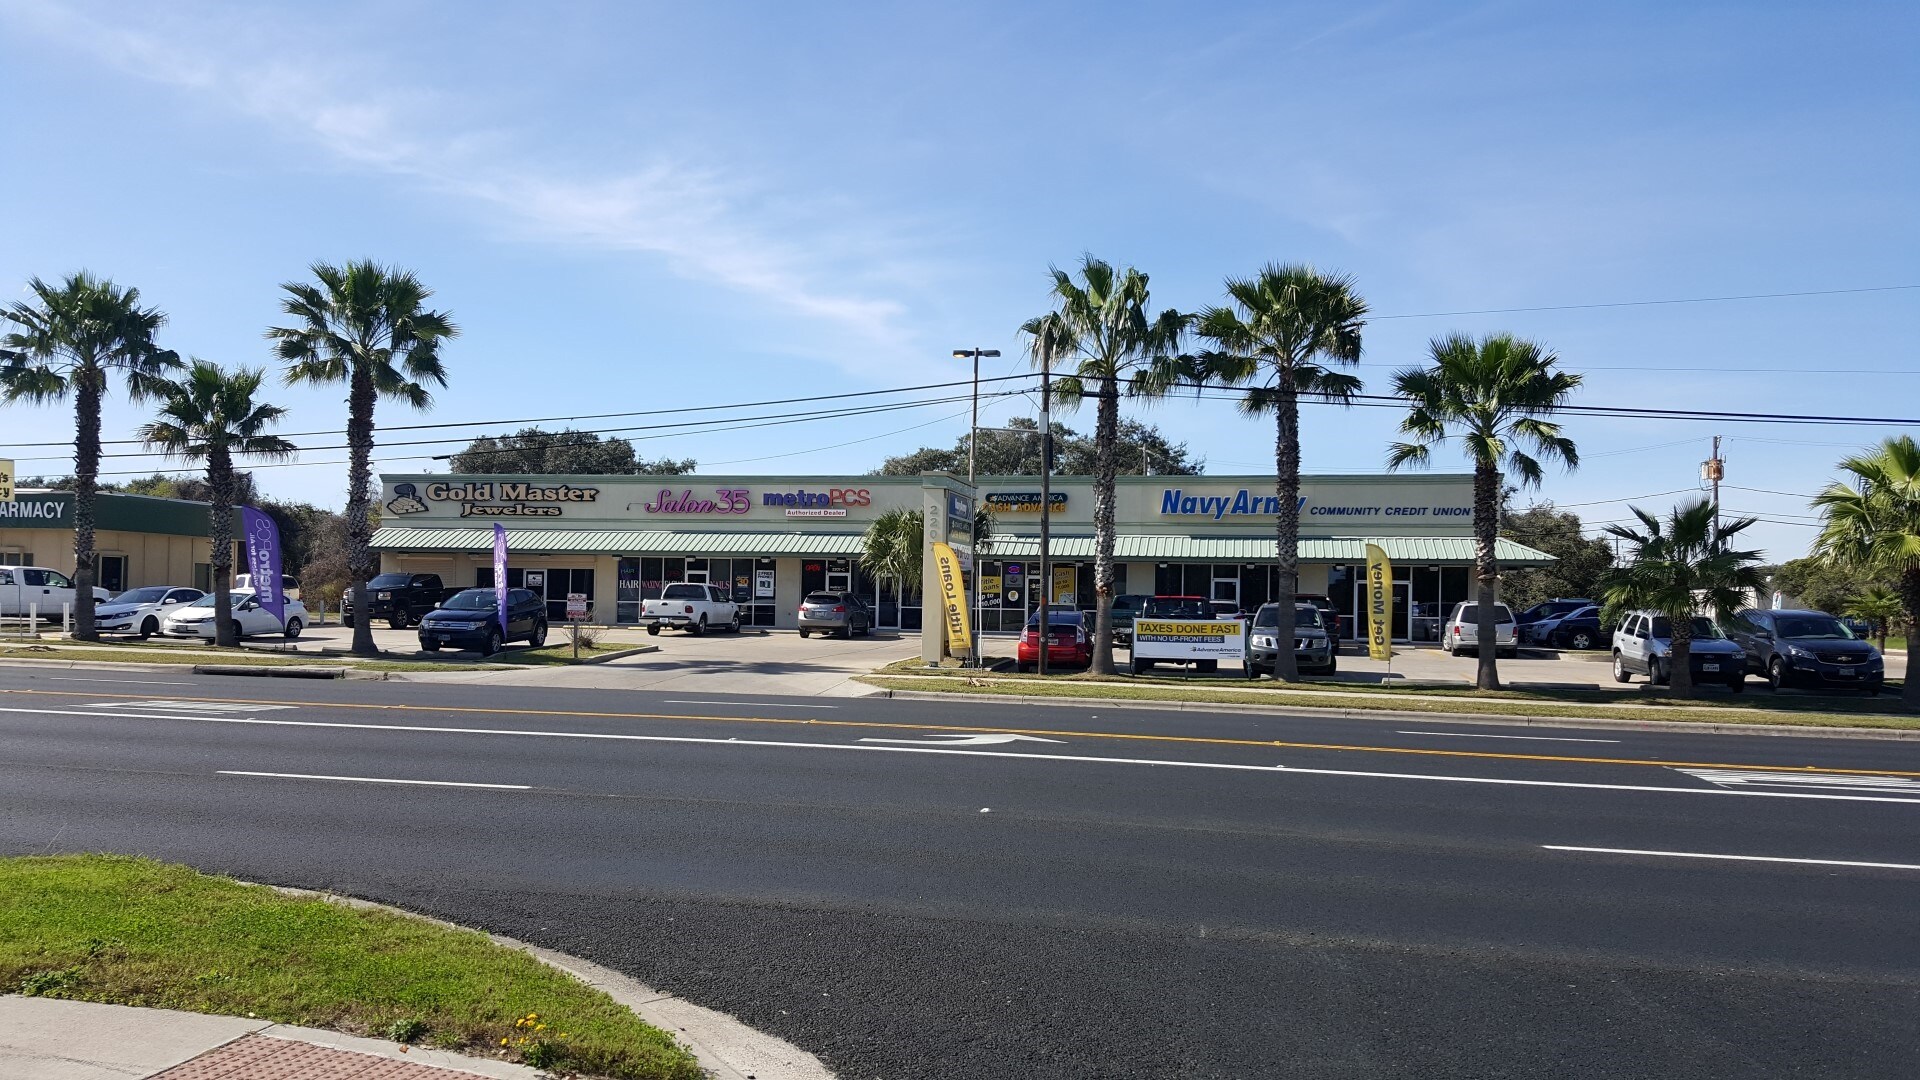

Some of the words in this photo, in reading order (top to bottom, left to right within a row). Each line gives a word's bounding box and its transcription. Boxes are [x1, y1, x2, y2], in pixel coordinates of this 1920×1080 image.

[426, 483, 494, 501] Gold
[500, 482, 600, 502] Master
[762, 488, 871, 507] metroPCS
[645, 489, 718, 514] Salon
[716, 489, 751, 514] 35
[460, 503, 563, 518] Jewelers
[1310, 506, 1381, 516] COMMUNITY
[1384, 507, 1428, 516] CREDIT
[1432, 507, 1471, 516] UNION
[619, 580, 639, 589] HAIR
[1139, 623, 1173, 633] TAXES
[1176, 624, 1208, 634] DONE
[1210, 625, 1239, 634] FAST
[1169, 635, 1202, 643] UP-FRONT
